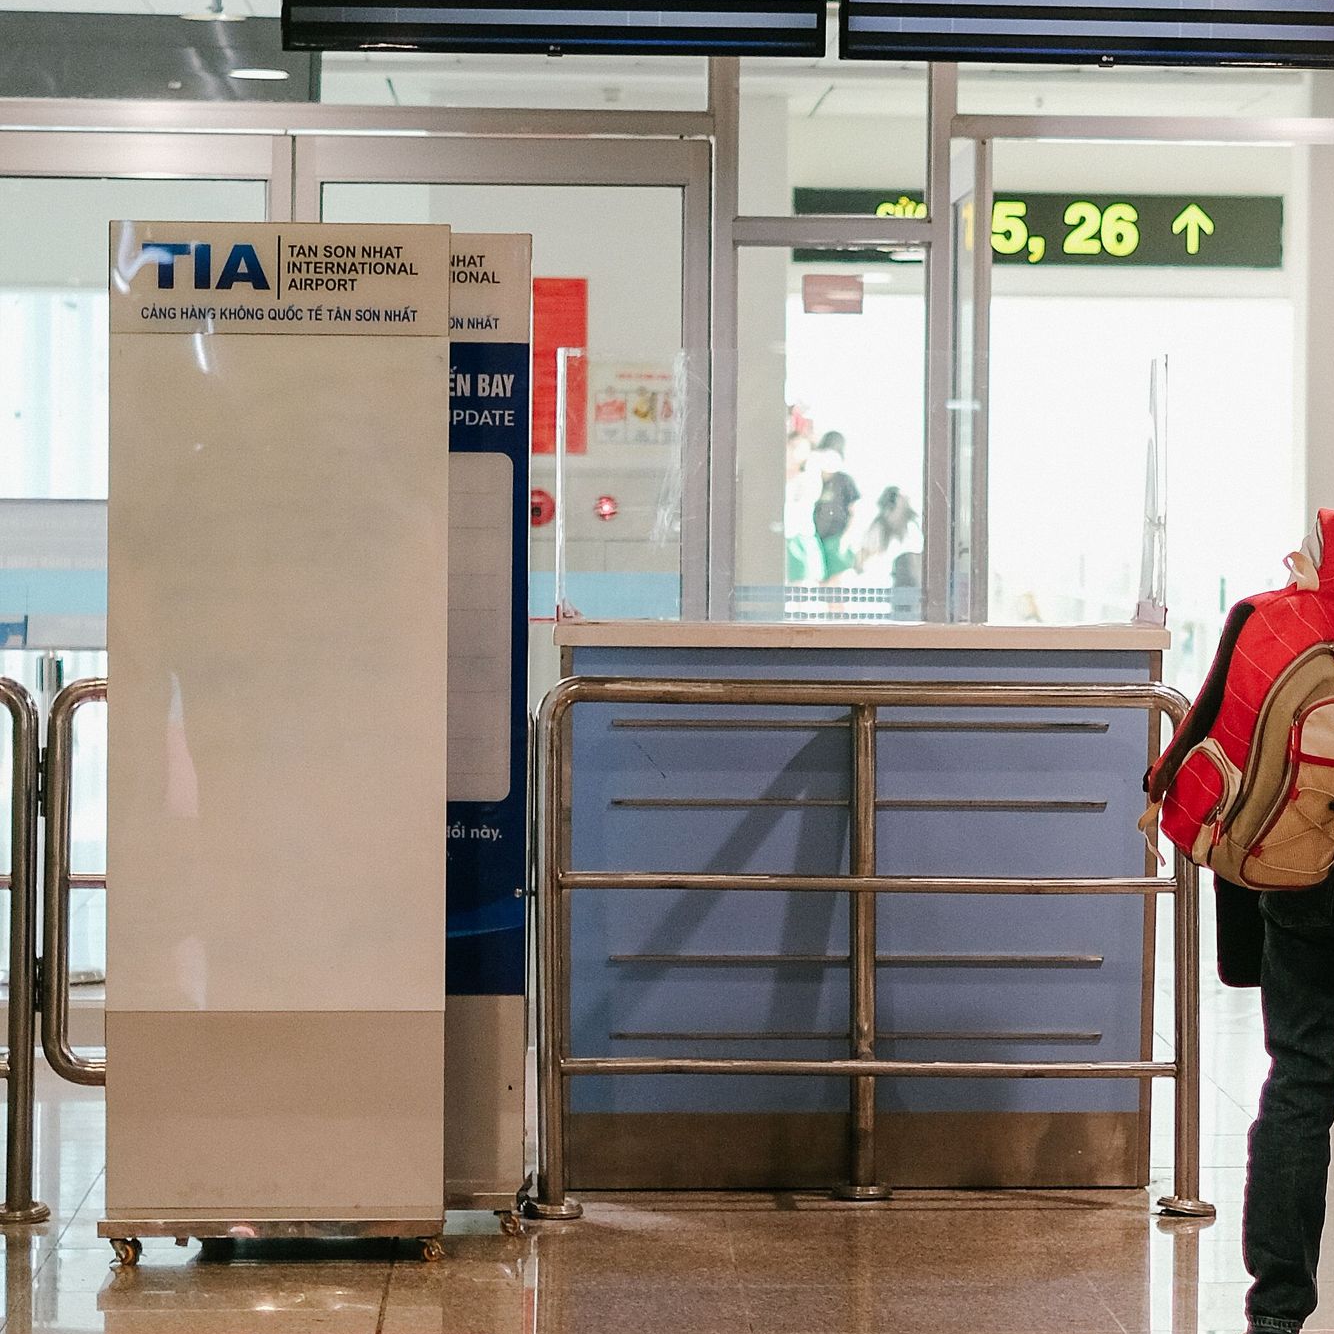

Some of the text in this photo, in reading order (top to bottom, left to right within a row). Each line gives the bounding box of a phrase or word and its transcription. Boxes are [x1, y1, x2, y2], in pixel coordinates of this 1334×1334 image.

[1063, 202, 1140, 257] 26
[288, 245, 403, 259] TAN SON NHAT
[142, 243, 270, 289] TIA
[287, 261, 418, 275] INTERNATIONAL
[288, 278, 357, 291] AIRPORT
[220, 305, 264, 321] KHÔNG
[355, 307, 380, 322] SƠN
[384, 305, 418, 322] NHẤT
[478, 374, 515, 397] BAY
[449, 410, 515, 426] PDATE
